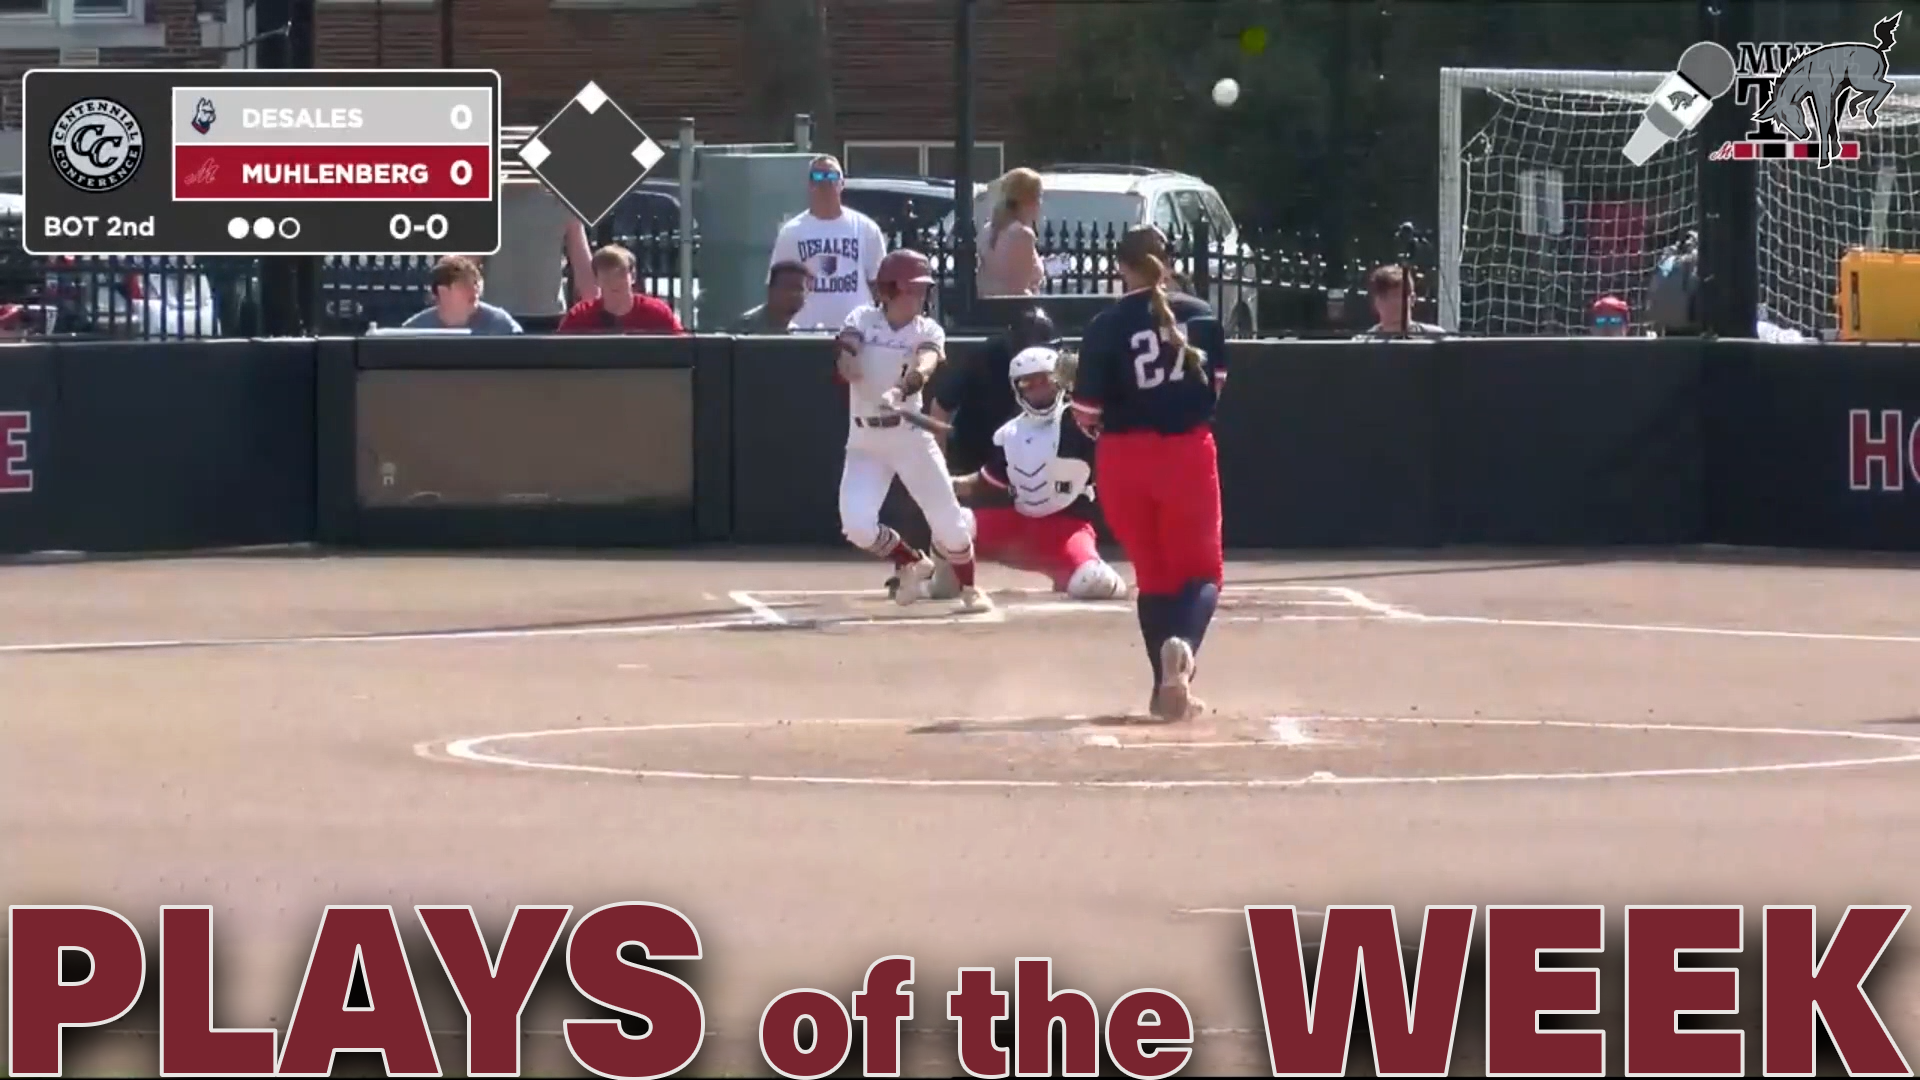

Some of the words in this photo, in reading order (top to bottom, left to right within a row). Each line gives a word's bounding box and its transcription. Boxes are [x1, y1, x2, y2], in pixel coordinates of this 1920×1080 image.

[798, 237, 859, 262] DESALES
[804, 270, 859, 293] ULLDOGS
[1130, 323, 1188, 389] 27
